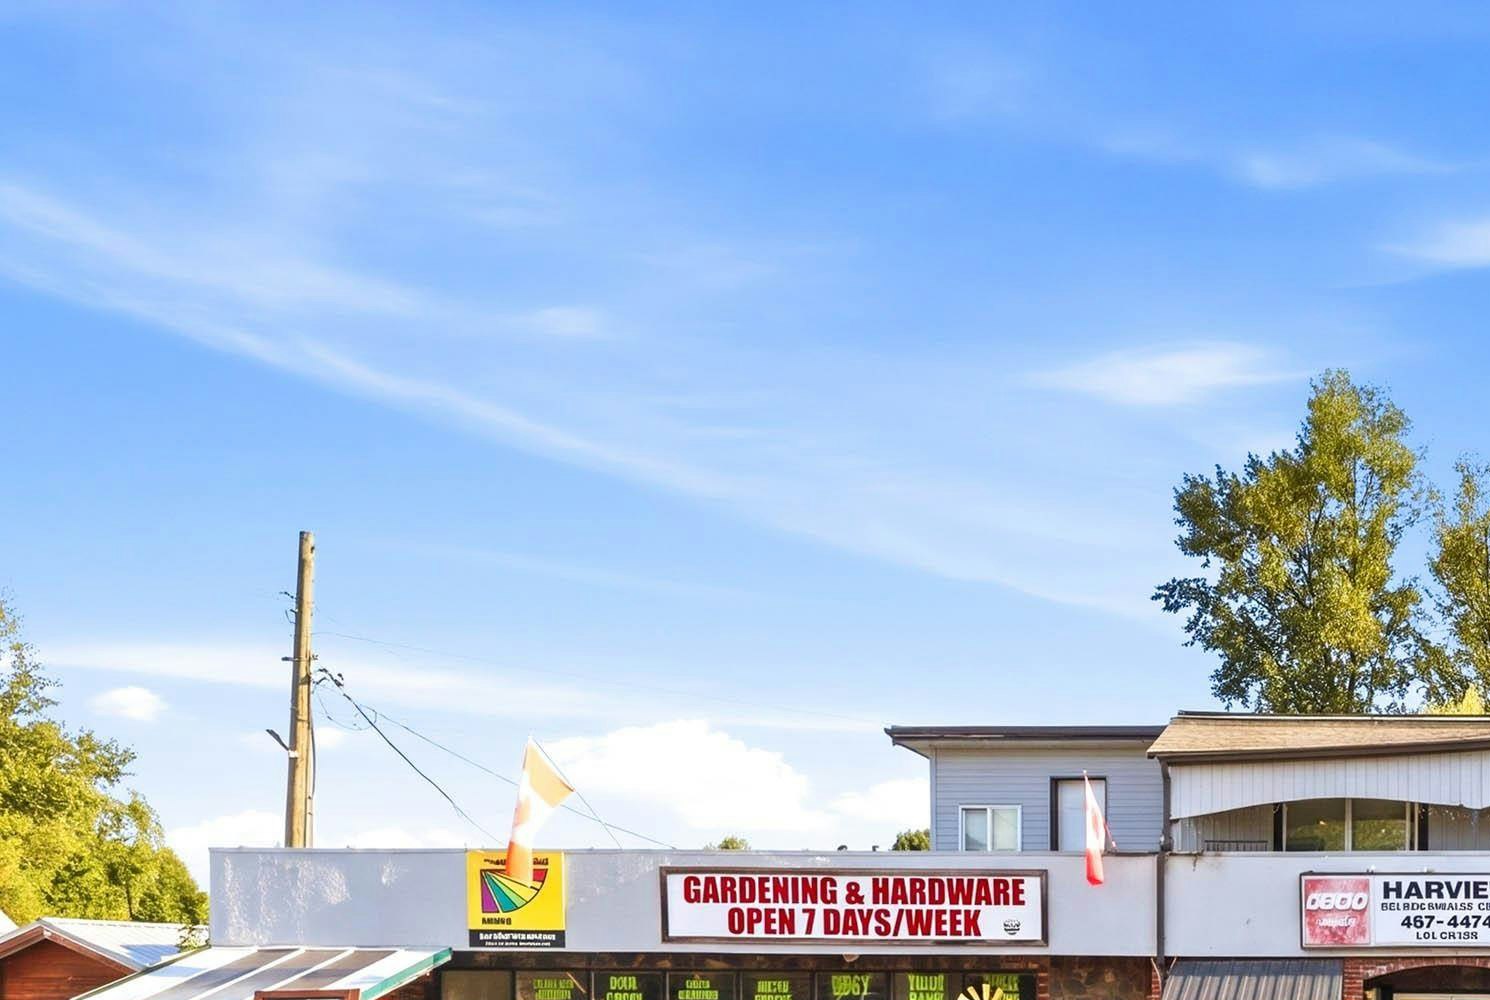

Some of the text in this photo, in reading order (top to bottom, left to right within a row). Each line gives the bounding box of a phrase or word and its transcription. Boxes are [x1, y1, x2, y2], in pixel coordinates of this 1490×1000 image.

[683, 875, 1026, 907] GARDENING & HARDWARE
[727, 907, 982, 938] OPEN 7 DAYS/WEEK
